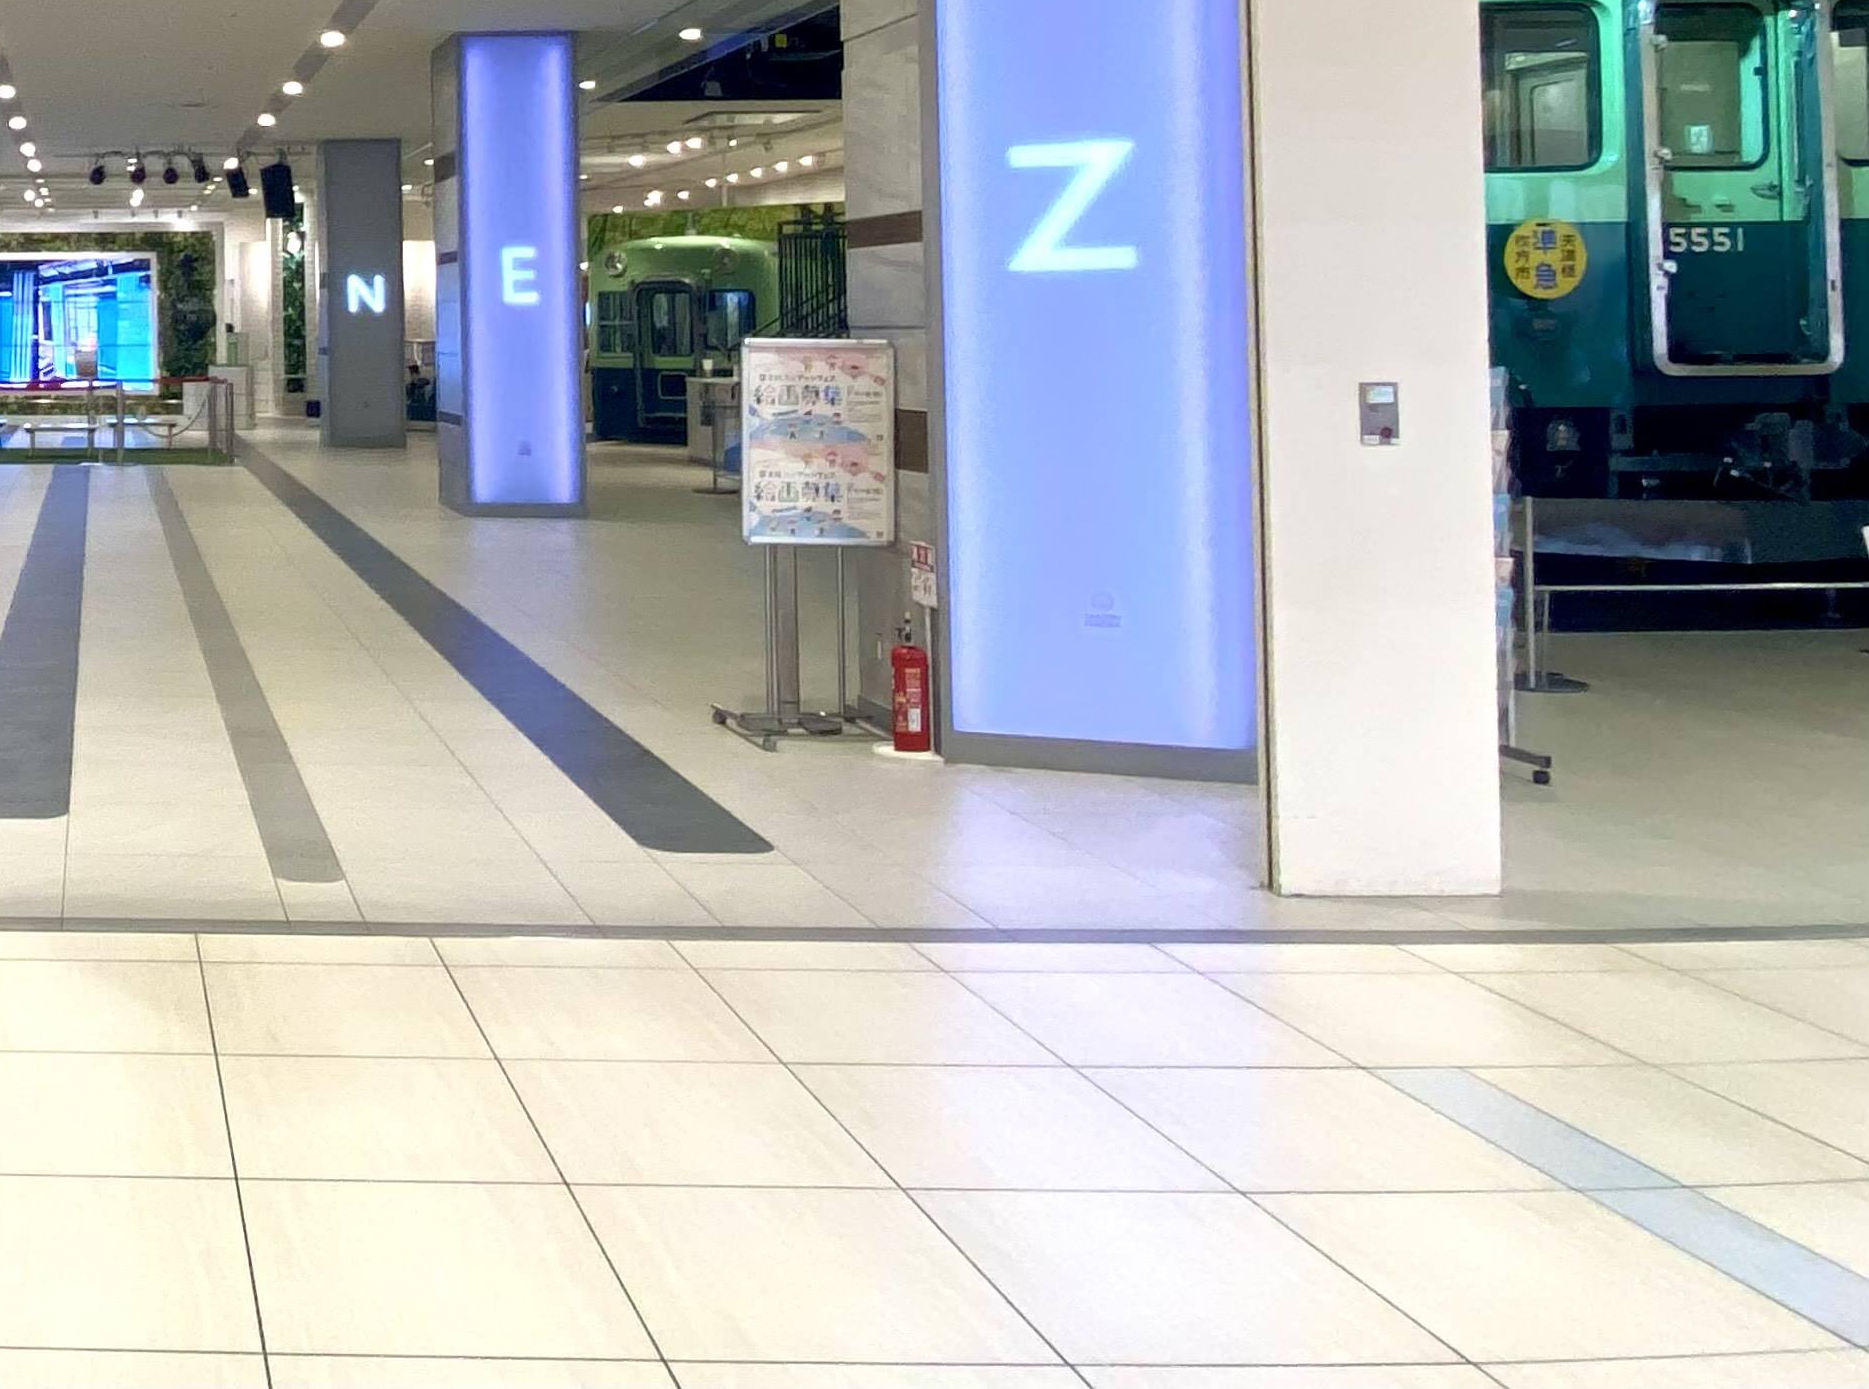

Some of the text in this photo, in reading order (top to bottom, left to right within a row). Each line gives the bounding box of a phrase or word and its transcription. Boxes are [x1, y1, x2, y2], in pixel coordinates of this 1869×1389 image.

[1007, 138, 1138, 273] Z
[1668, 227, 1745, 253] 5551
[346, 273, 386, 314] N
[499, 245, 541, 306] E
